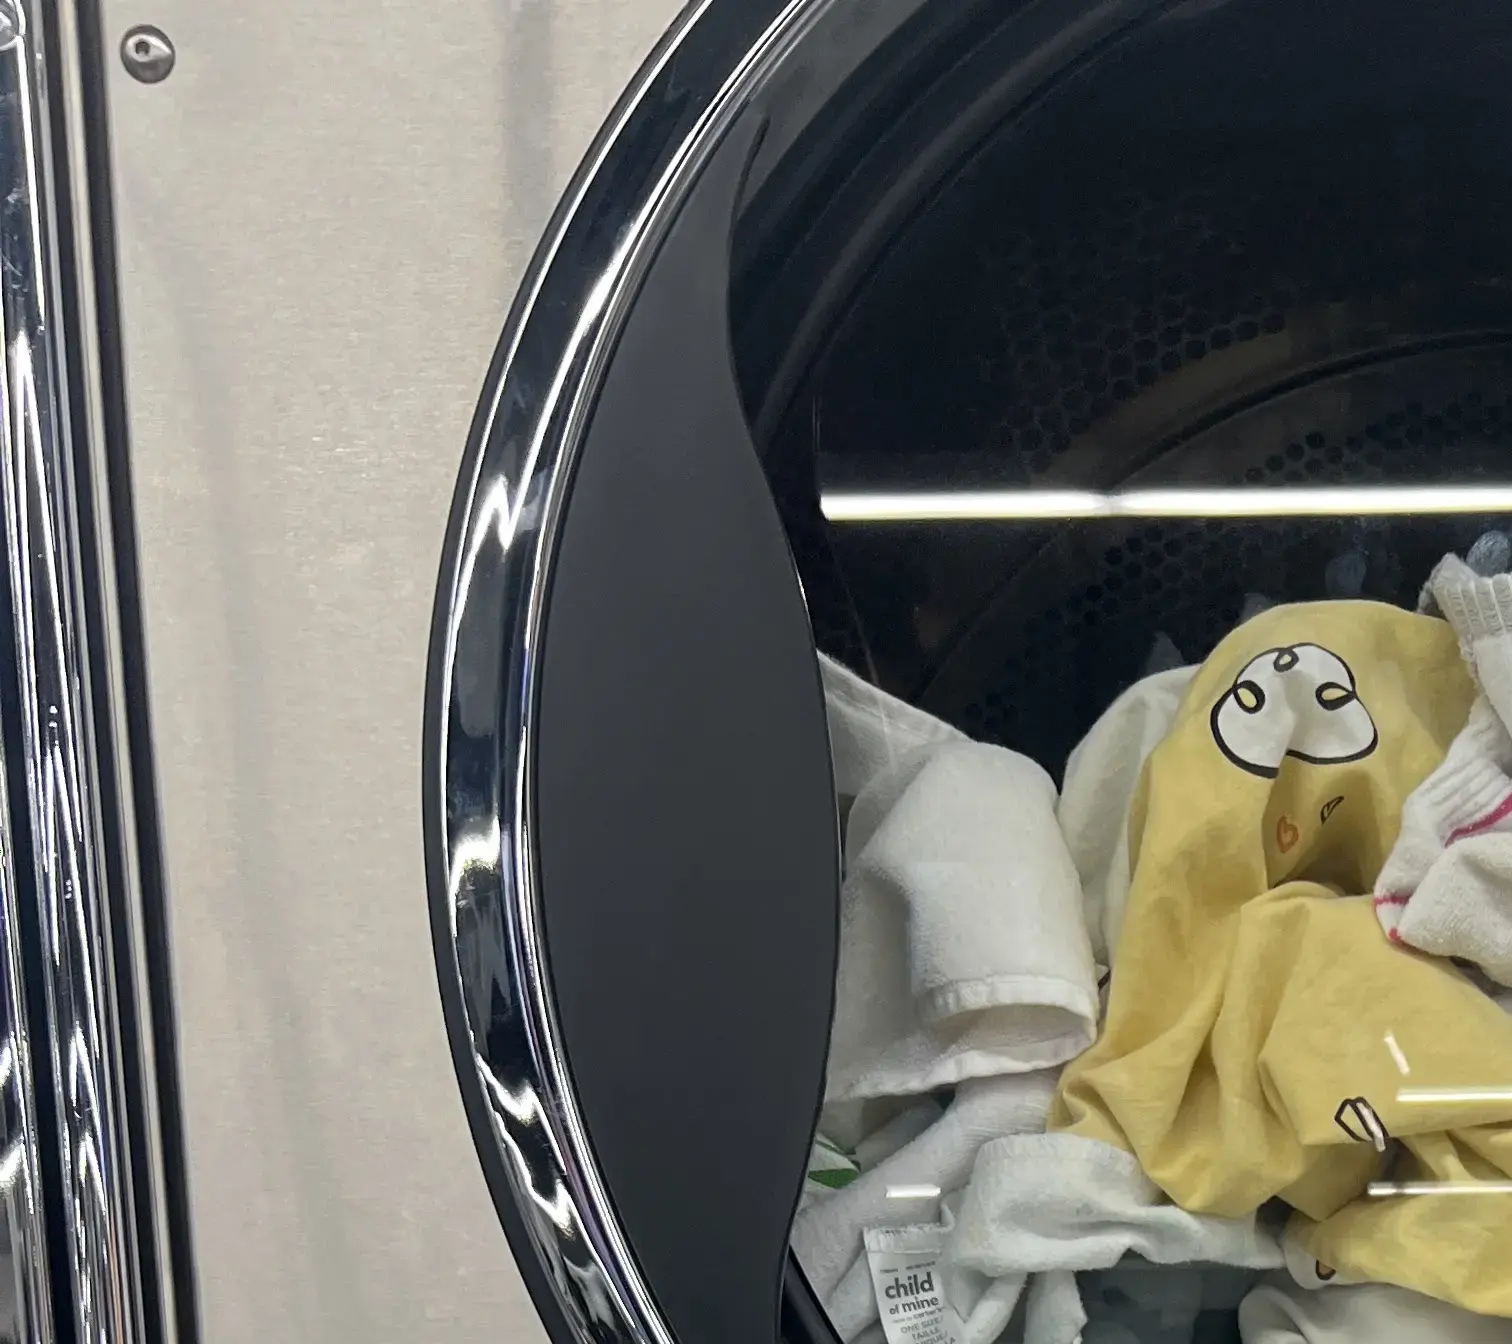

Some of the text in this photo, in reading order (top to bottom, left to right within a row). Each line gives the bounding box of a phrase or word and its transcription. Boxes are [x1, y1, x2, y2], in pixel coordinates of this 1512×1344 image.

[885, 1271, 934, 1299] child
[889, 1296, 939, 1315] of mine
[900, 1321, 920, 1334] ONE
[912, 1327, 940, 1341] TAILLE
